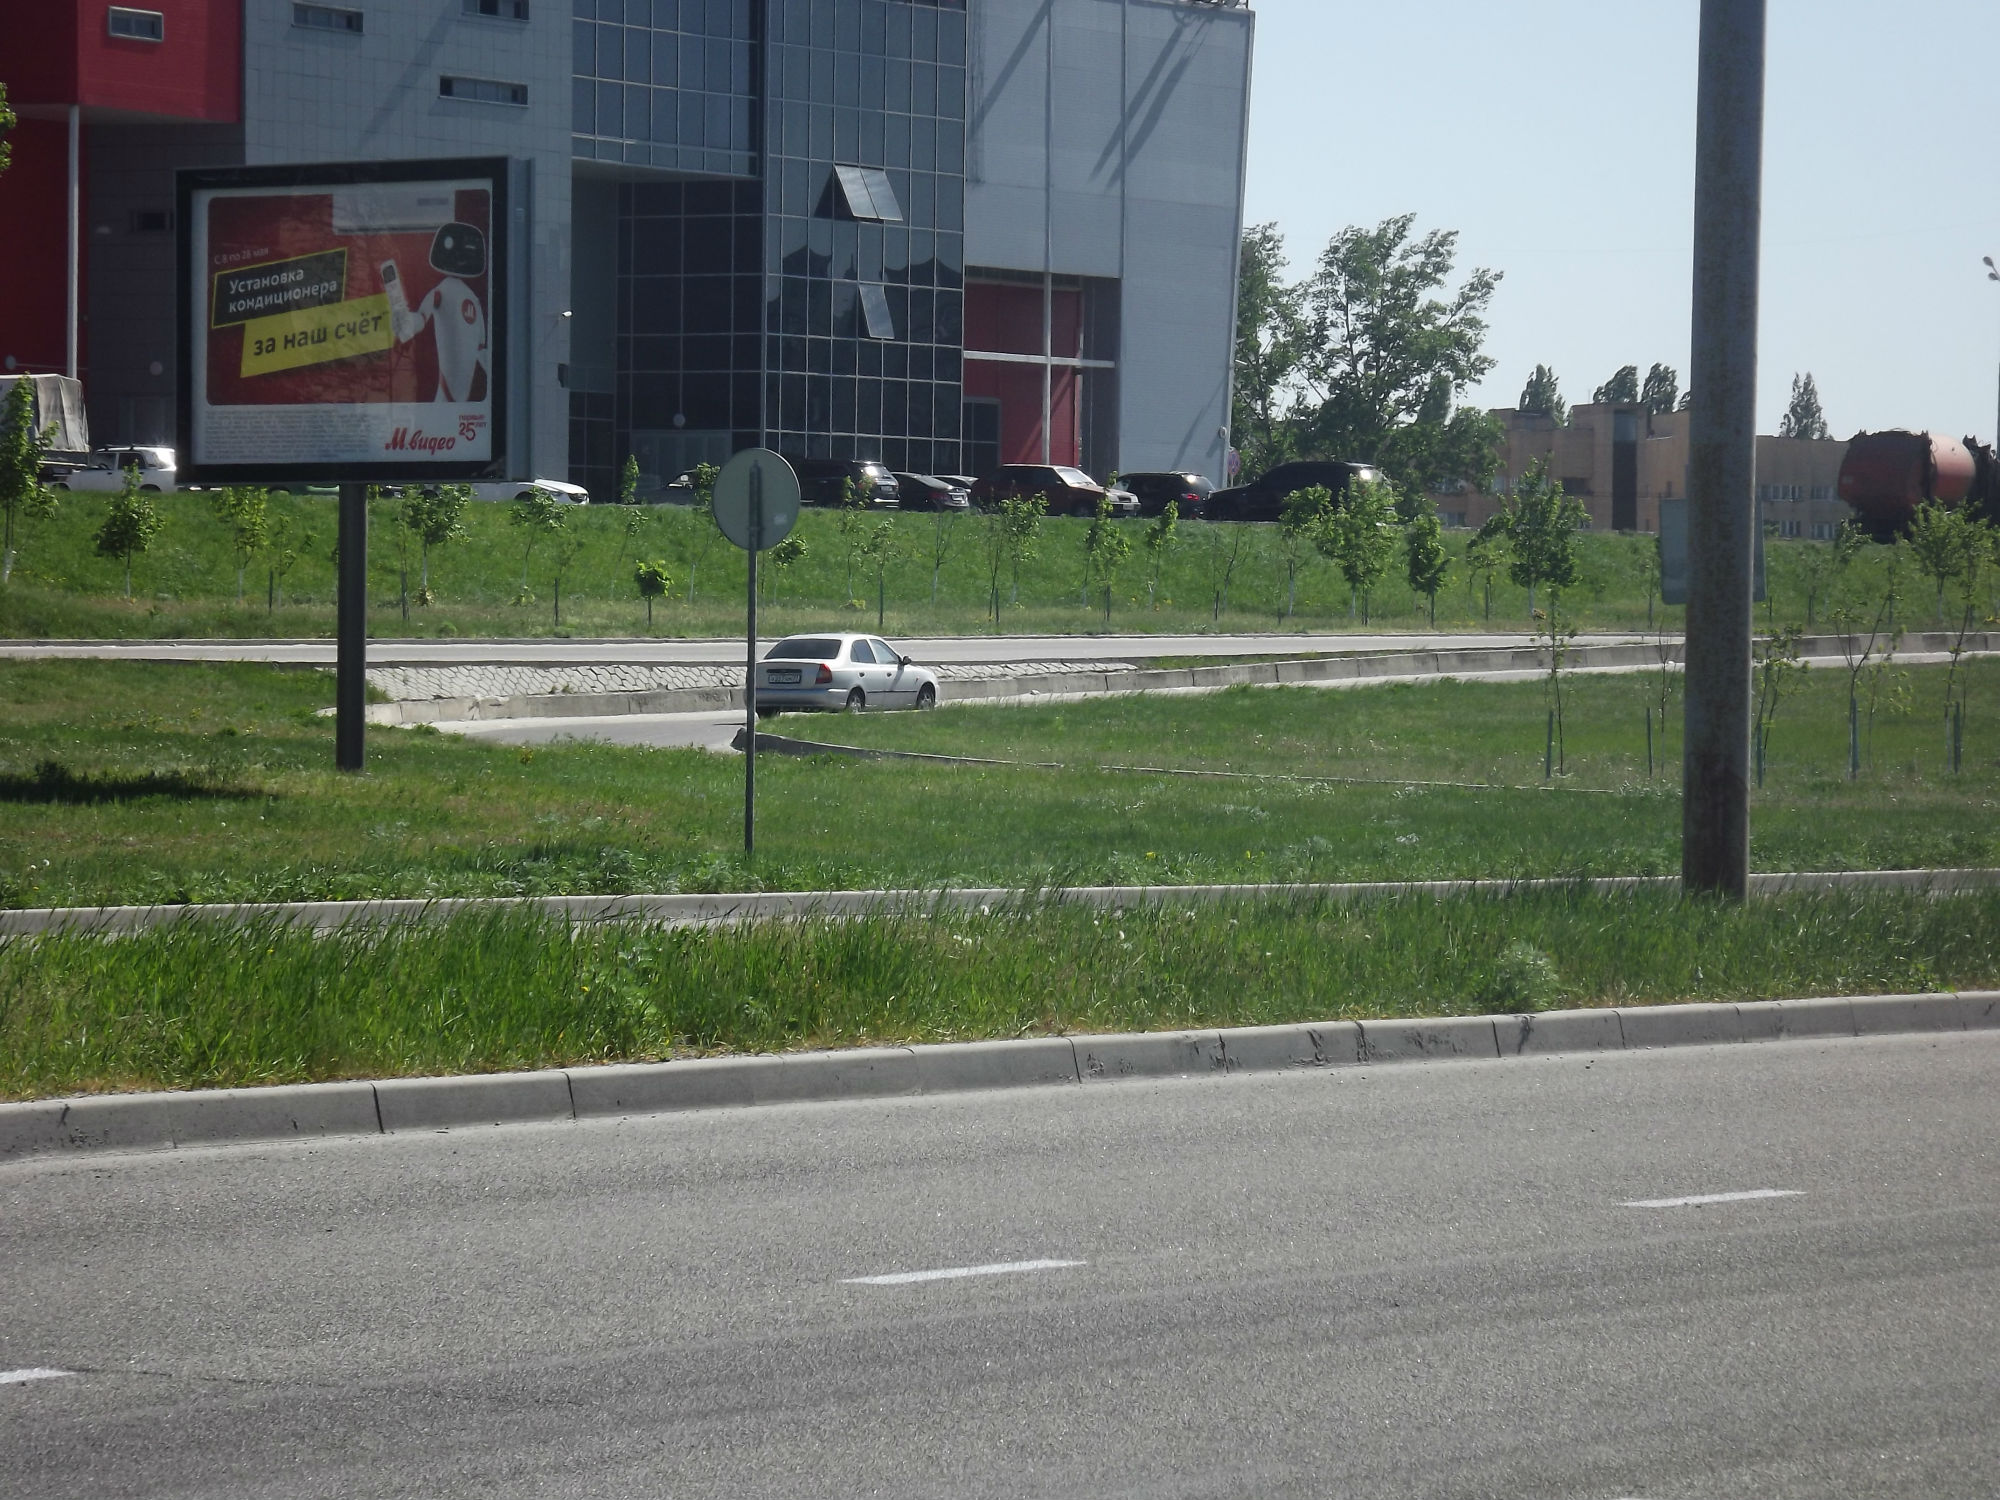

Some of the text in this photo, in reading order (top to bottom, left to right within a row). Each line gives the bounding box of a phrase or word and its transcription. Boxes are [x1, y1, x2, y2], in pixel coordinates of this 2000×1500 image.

[229, 269, 305, 294] Установка
[229, 280, 338, 313] кондиционера
[253, 337, 276, 356] за
[283, 326, 327, 350] наш
[384, 427, 456, 456] М.видео
[459, 422, 476, 441] 25
